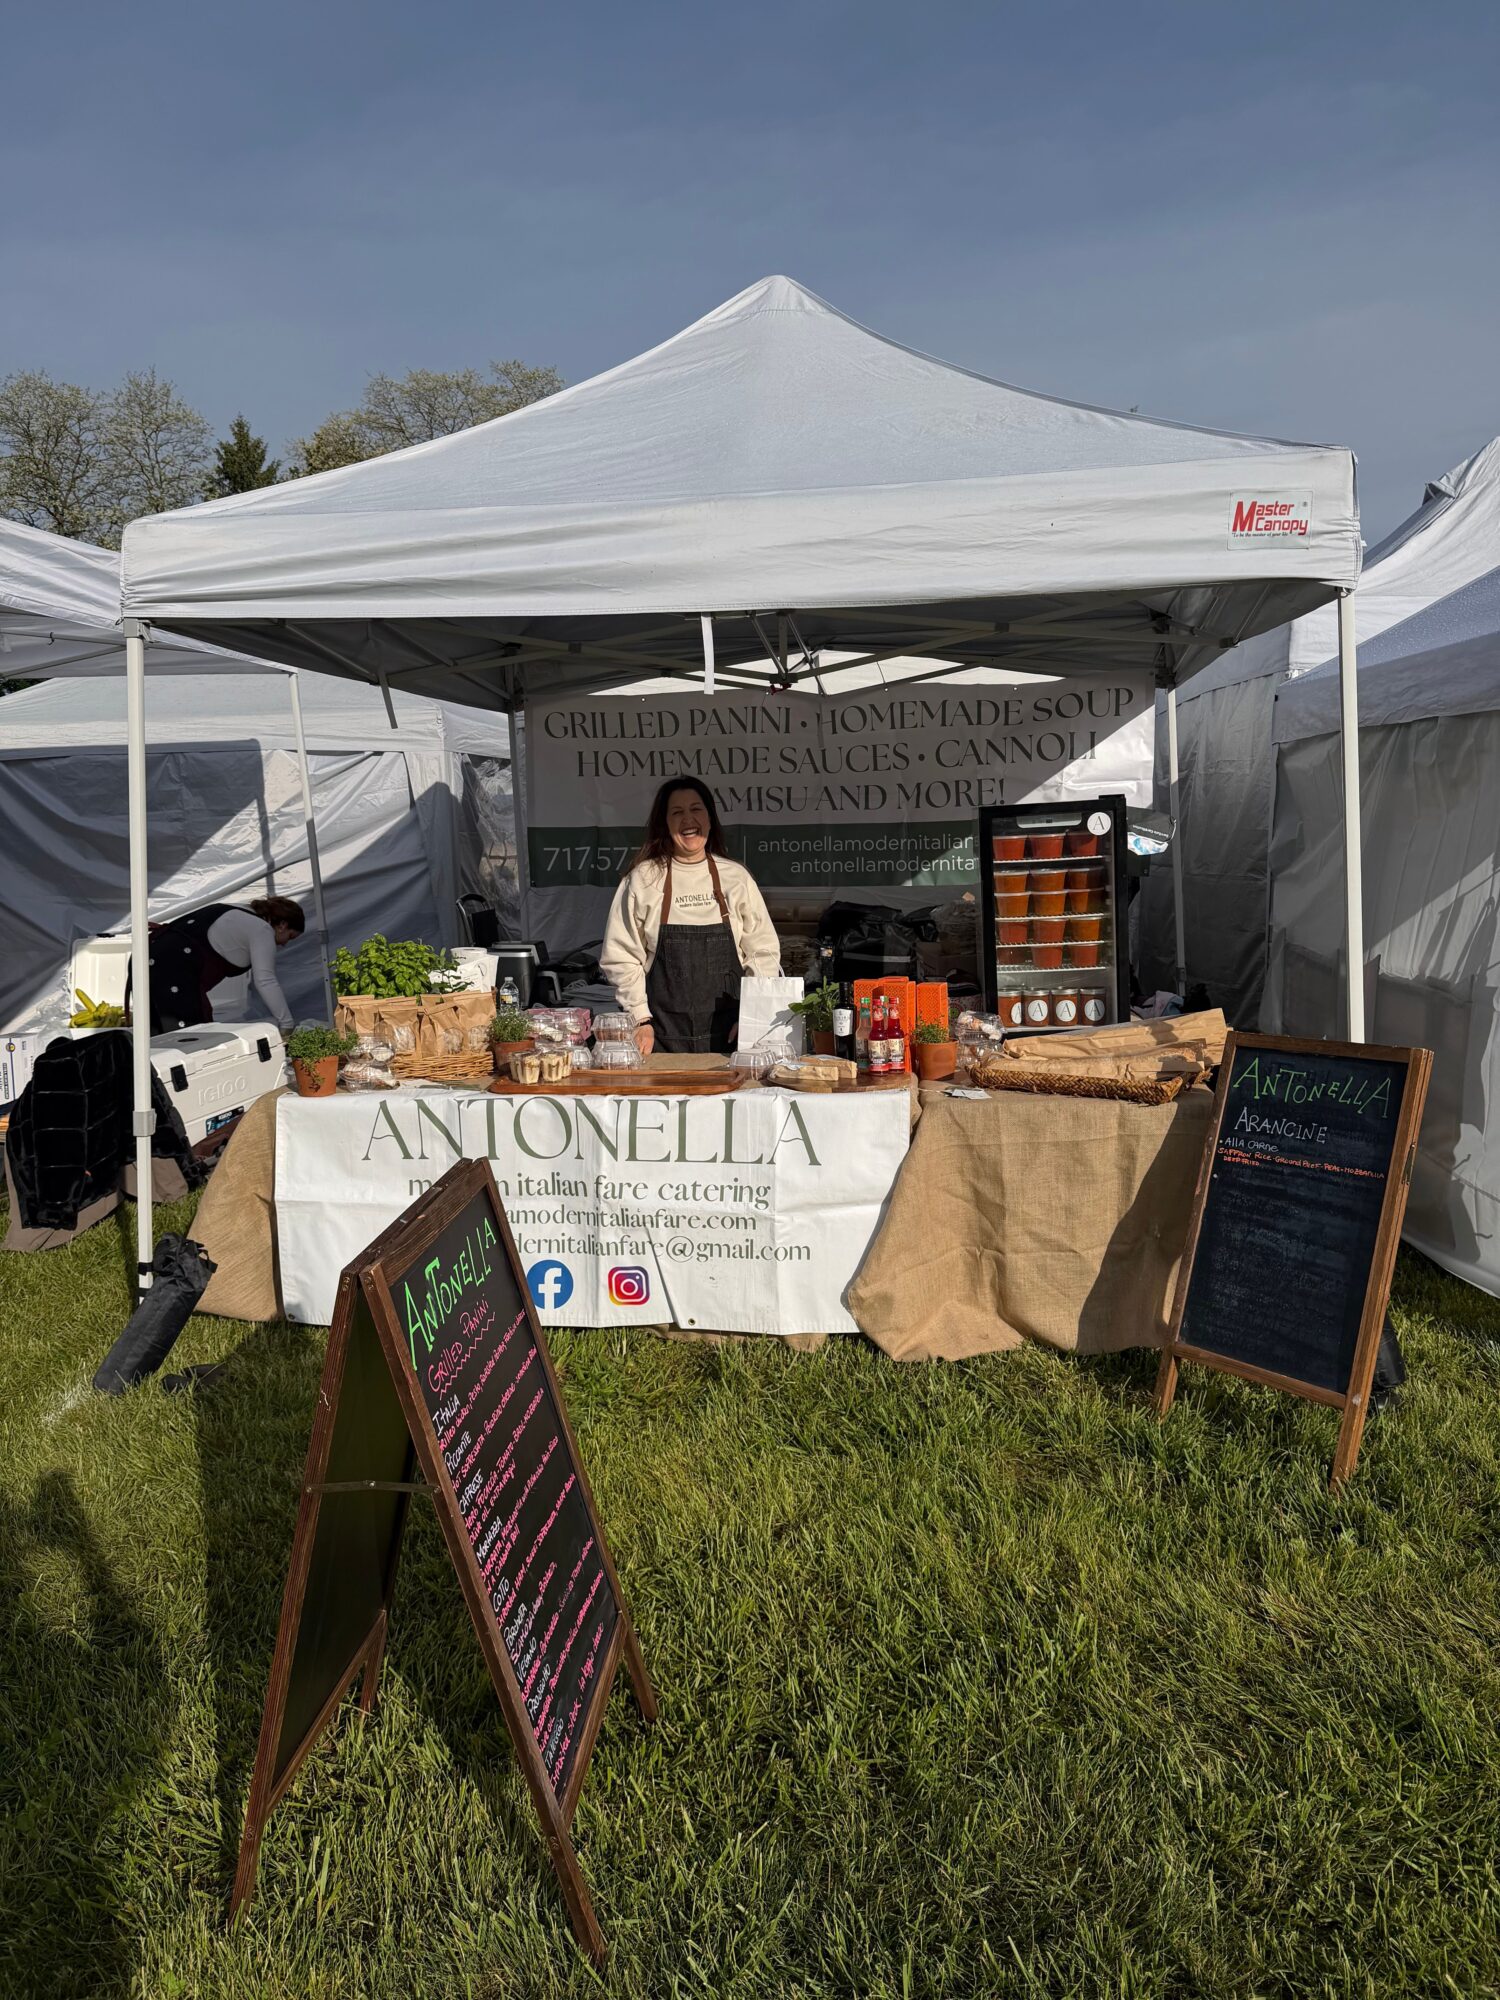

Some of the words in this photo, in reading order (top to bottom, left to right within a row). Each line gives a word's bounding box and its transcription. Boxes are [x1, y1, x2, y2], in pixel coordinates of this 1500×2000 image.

[543, 707, 680, 741] GRILLED
[690, 705, 792, 736] PANINI
[817, 696, 1023, 735] HOMEMADE
[1032, 686, 1135, 726] SOUP
[576, 745, 771, 778] HOMEMADE
[794, 742, 910, 775] SAUCES
[934, 731, 1097, 770] CANNOLI
[713, 786, 808, 813] AMISU
[815, 784, 888, 812] AND
[897, 778, 1005, 810] MORE!
[543, 846, 642, 872] 717.57
[790, 855, 977, 874] antonellamodernita
[1233, 1057, 1392, 1119] ANTONELLA
[361, 1094, 822, 1167] ANTONELLA
[1234, 1106, 1328, 1144] ARANCINE
[518, 1171, 587, 1198] italian
[594, 1172, 648, 1203] fare
[658, 1178, 771, 1210] catering
[506, 1205, 757, 1230] amodernitalianfare.com
[514, 1234, 812, 1263] dernitalianfare@gmail.com
[405, 1218, 496, 1370] ANTONELLA
